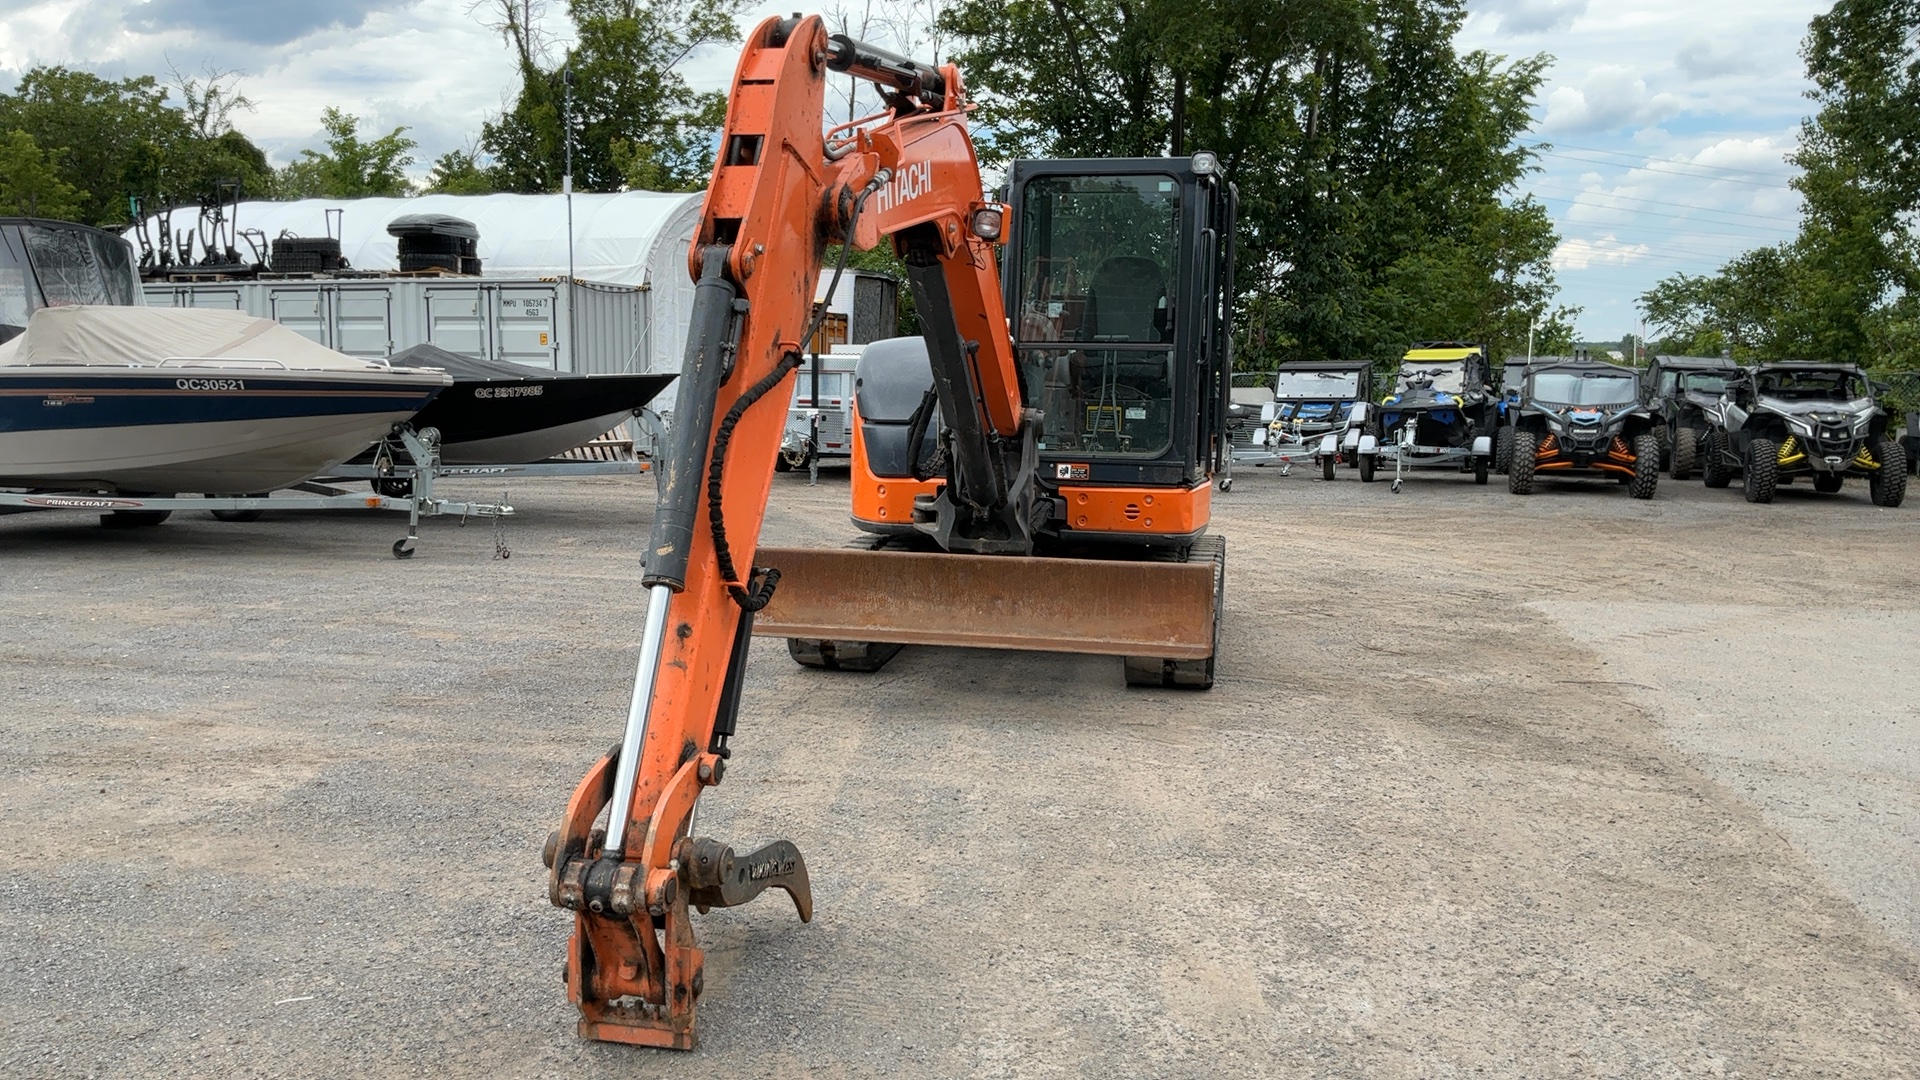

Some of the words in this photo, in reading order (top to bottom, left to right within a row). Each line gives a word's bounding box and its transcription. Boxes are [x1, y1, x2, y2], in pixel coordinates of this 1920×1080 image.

[876, 159, 932, 215] HITACHI
[175, 378, 246, 391] QC30521
[474, 387, 493, 399] QC
[45, 499, 114, 507] PRINCECRAFT
